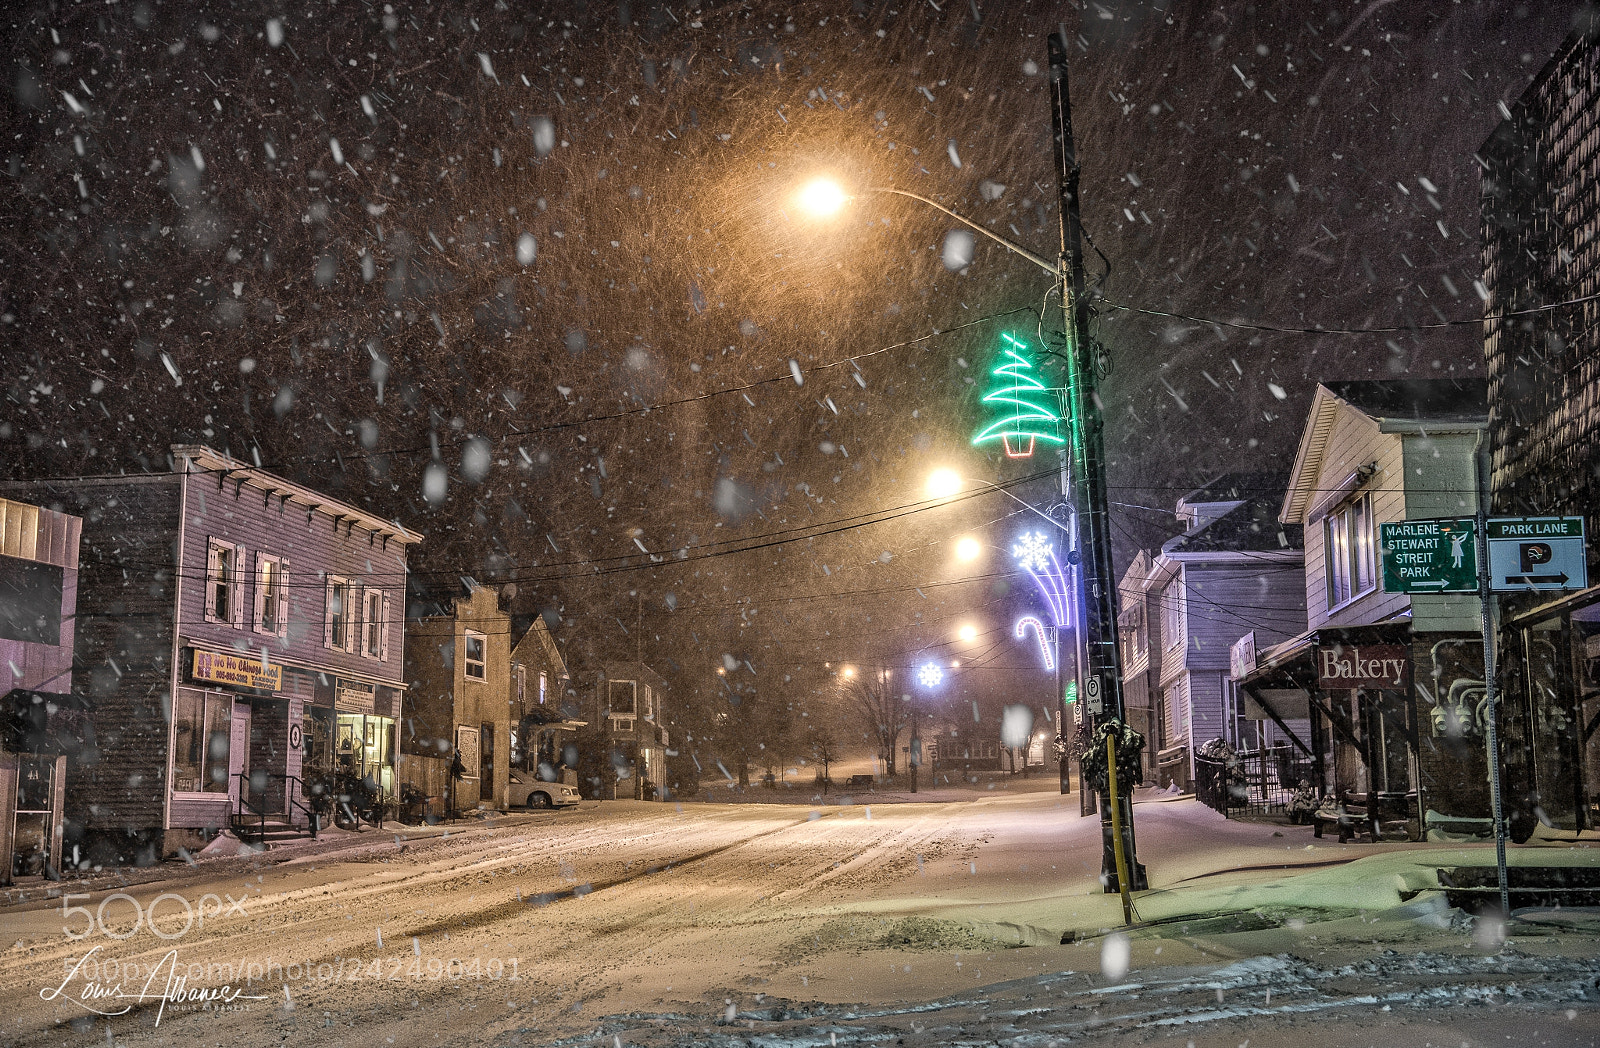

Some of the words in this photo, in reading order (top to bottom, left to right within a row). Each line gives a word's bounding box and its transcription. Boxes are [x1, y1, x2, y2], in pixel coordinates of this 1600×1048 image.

[1386, 524, 1440, 536] MARLENE
[1501, 525, 1534, 535] PARK
[1535, 523, 1569, 534] LANE
[1388, 538, 1440, 550] STEWART
[1395, 552, 1434, 564] STREIT
[1519, 543, 1553, 573] P
[1400, 567, 1431, 578] PARK
[1321, 649, 1406, 685] Bakery
